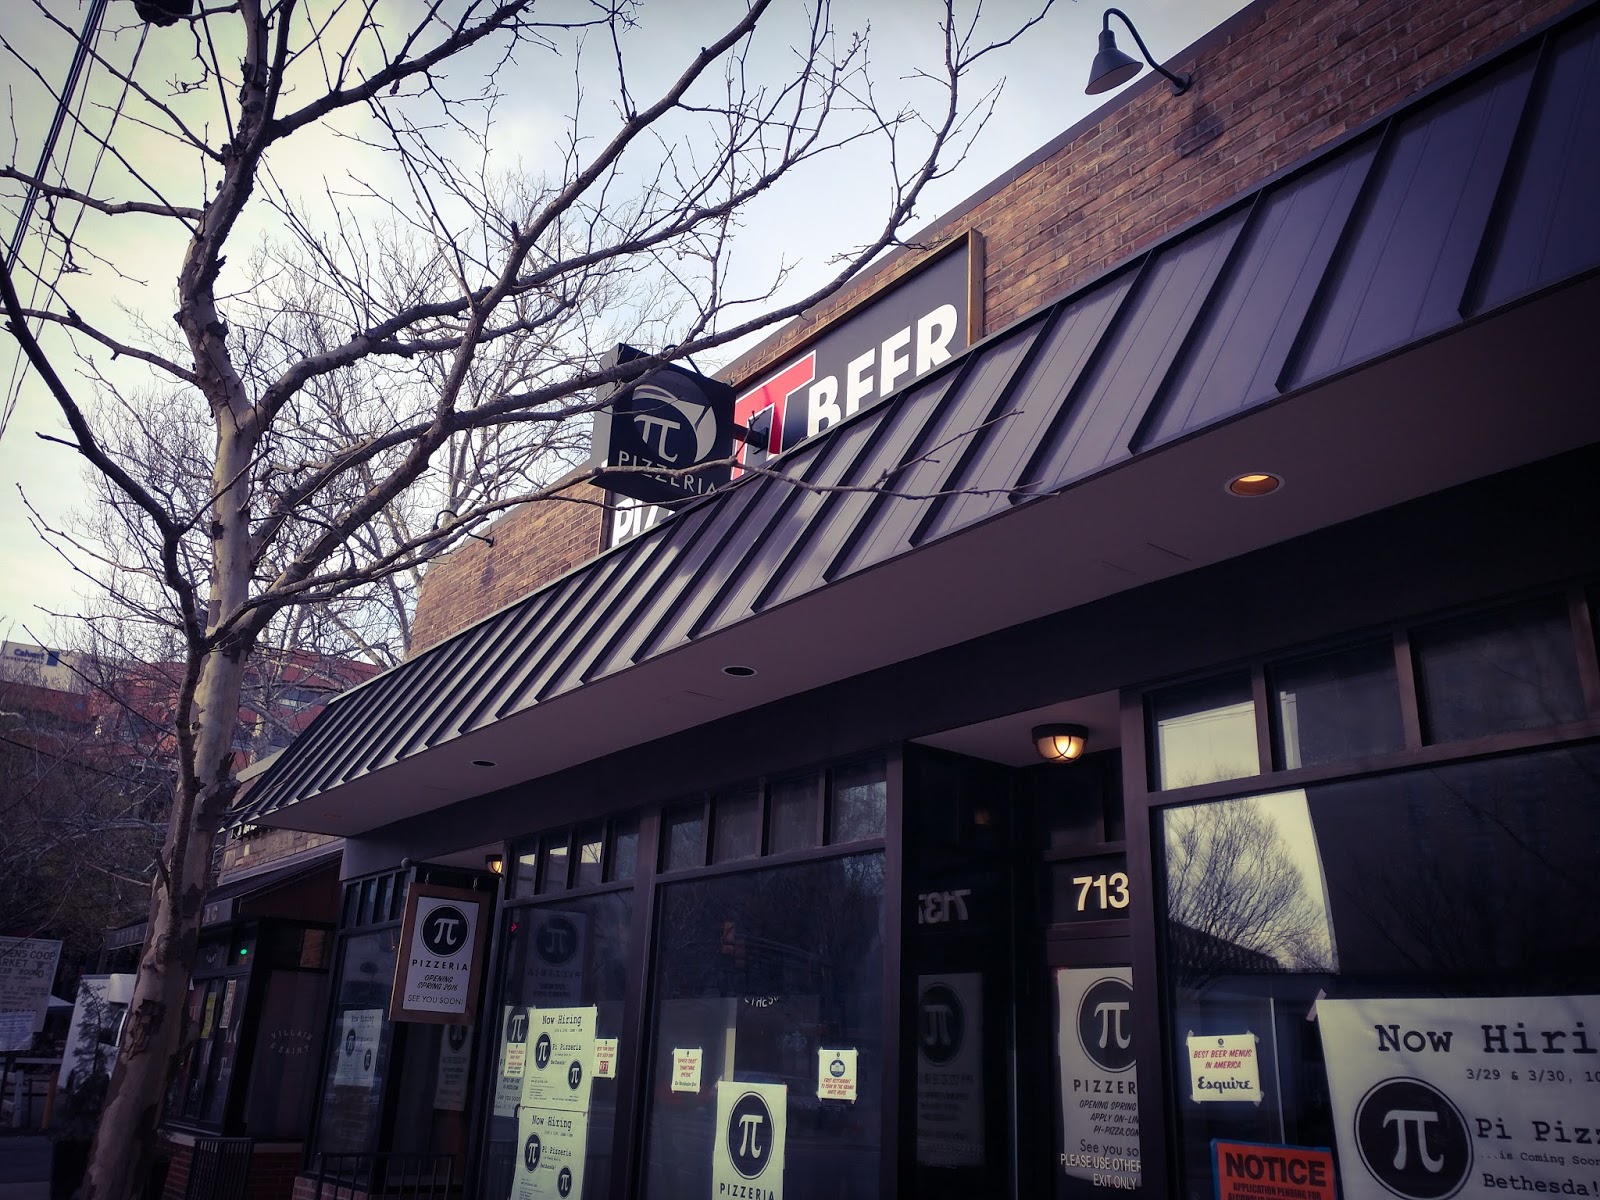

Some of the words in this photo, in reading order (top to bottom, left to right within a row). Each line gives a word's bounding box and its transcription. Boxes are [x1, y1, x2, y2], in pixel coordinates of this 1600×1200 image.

[808, 304, 957, 437] BEER
[618, 450, 718, 494] PIZZERIA
[1073, 872, 1130, 911] 713
[412, 959, 468, 971] PIZZERIA
[417, 981, 441, 990] SPRING
[424, 974, 454, 983] OPENING
[422, 995, 438, 1004] YOU
[542, 1015, 555, 1025] Now
[557, 1014, 582, 1027] Hiring
[1375, 1024, 1453, 1052] Now
[1481, 1022, 1600, 1054] Hiri
[1194, 1050, 1209, 1058] BEST
[1211, 1050, 1227, 1058] BEER
[1229, 1049, 1252, 1057] MENUS
[1205, 1061, 1212, 1069] IN
[1213, 1061, 1241, 1069] AMERICA
[1466, 1068, 1501, 1081] 3/29
[1511, 1071, 1519, 1081] &
[1528, 1070, 1573, 1083] 3/30,
[1073, 1079, 1137, 1094] PIZZER
[1197, 1076, 1254, 1094] Esquire
[1080, 1100, 1109, 1110] OPENING
[1110, 1101, 1137, 1111] SPRING
[532, 1114, 545, 1125] Now
[547, 1116, 572, 1131] Hiring
[1090, 1113, 1112, 1122] APPLY
[1475, 1118, 1512, 1140] Pi
[1080, 1139, 1099, 1153] See
[1103, 1145, 1123, 1159] you
[1126, 1147, 1139, 1157] so
[1060, 1153, 1092, 1168] PLEASE
[1093, 1156, 1111, 1170] USE
[1520, 1152, 1565, 1166] Coming
[1225, 1152, 1326, 1187] NOTICE
[1093, 1173, 1112, 1187] EXIT
[1114, 1176, 1137, 1190] ONLY
[1483, 1173, 1599, 1198] Bethesda!
[719, 1182, 774, 1200] PIZZERIA
[1233, 1182, 1276, 1196] APPLICATION
[1278, 1186, 1307, 1199] PENDING
[1308, 1190, 1321, 1200] FOR
